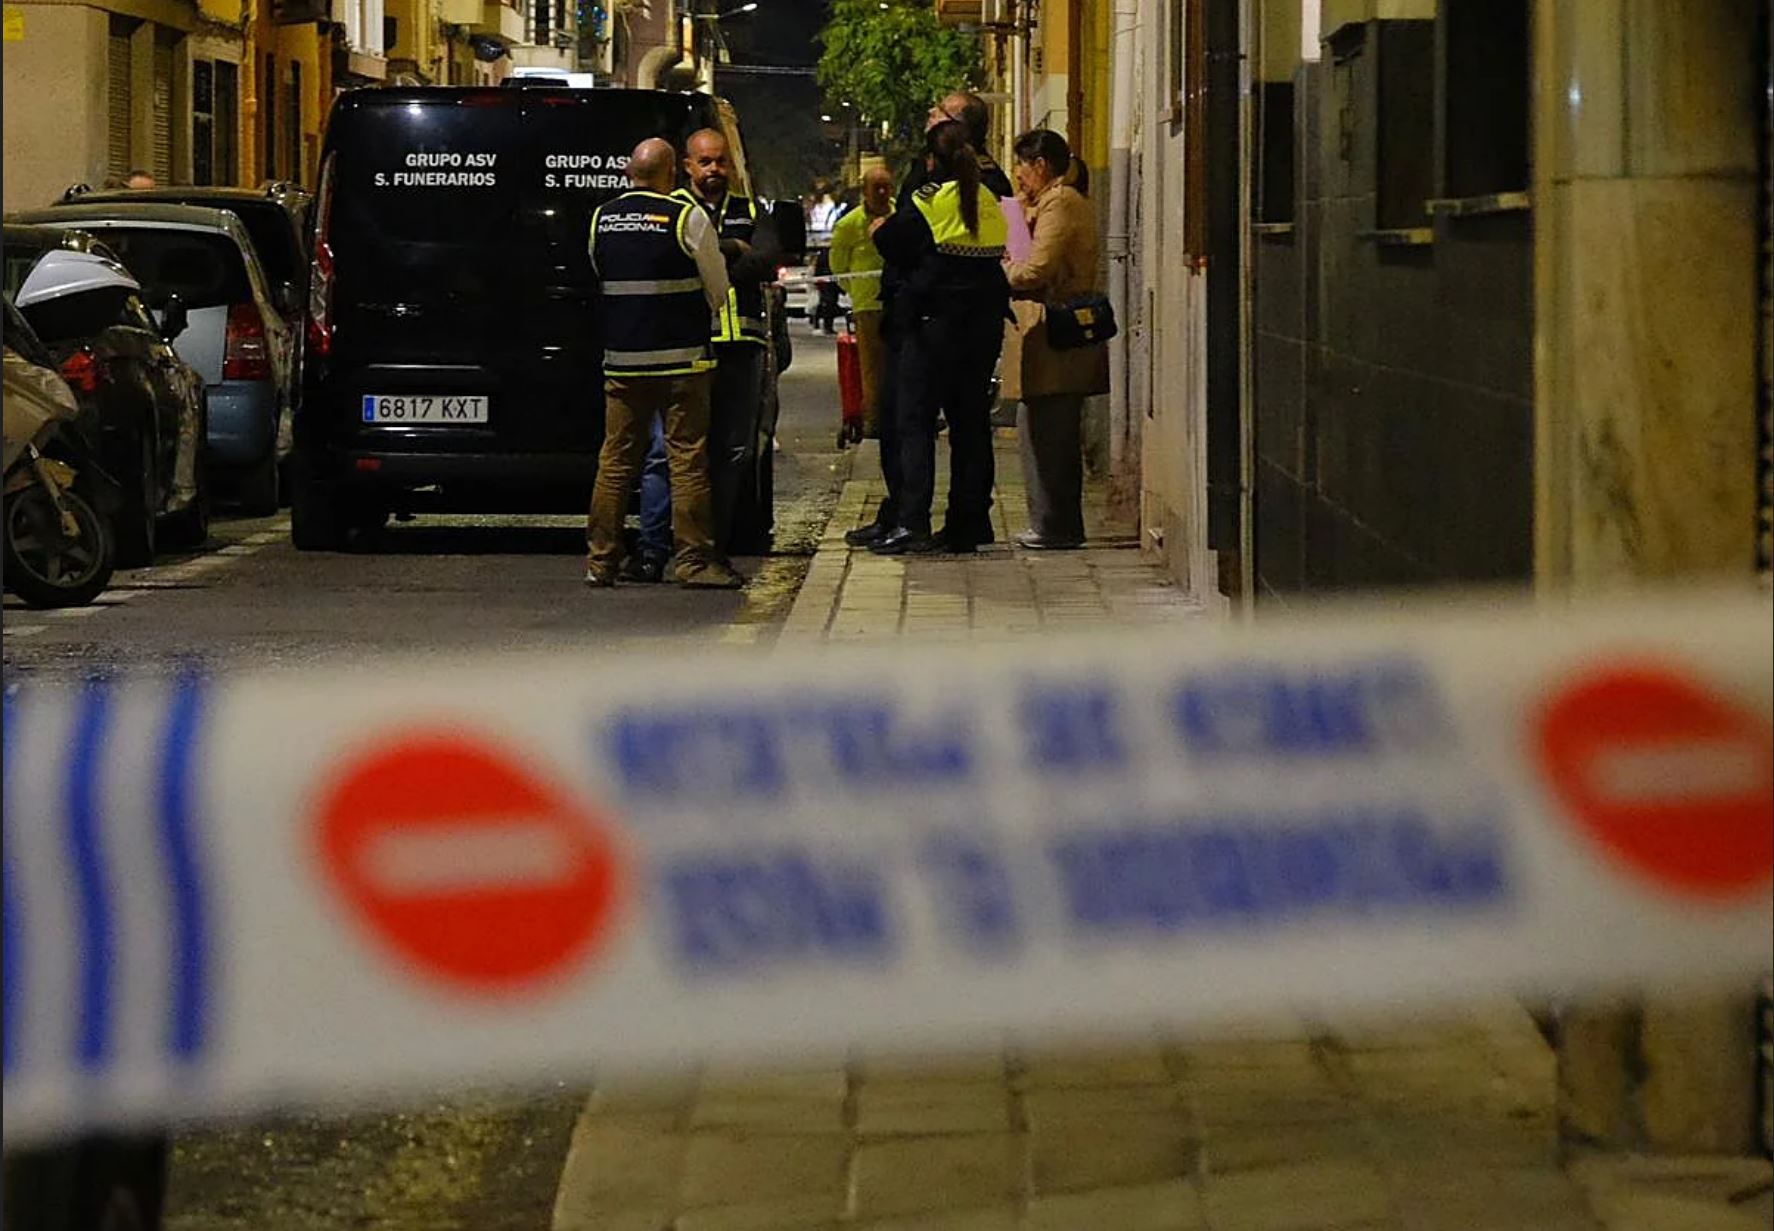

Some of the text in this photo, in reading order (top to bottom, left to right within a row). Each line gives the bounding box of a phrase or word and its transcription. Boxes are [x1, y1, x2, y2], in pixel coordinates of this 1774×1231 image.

[405, 153, 497, 167] GRUPO ASV
[545, 155, 602, 168] GRUPO
[374, 172, 496, 186] S. FUNERARIOS
[545, 174, 560, 188] S.
[598, 222, 668, 233] NACIONAL
[380, 398, 482, 418] 6817 KXT
